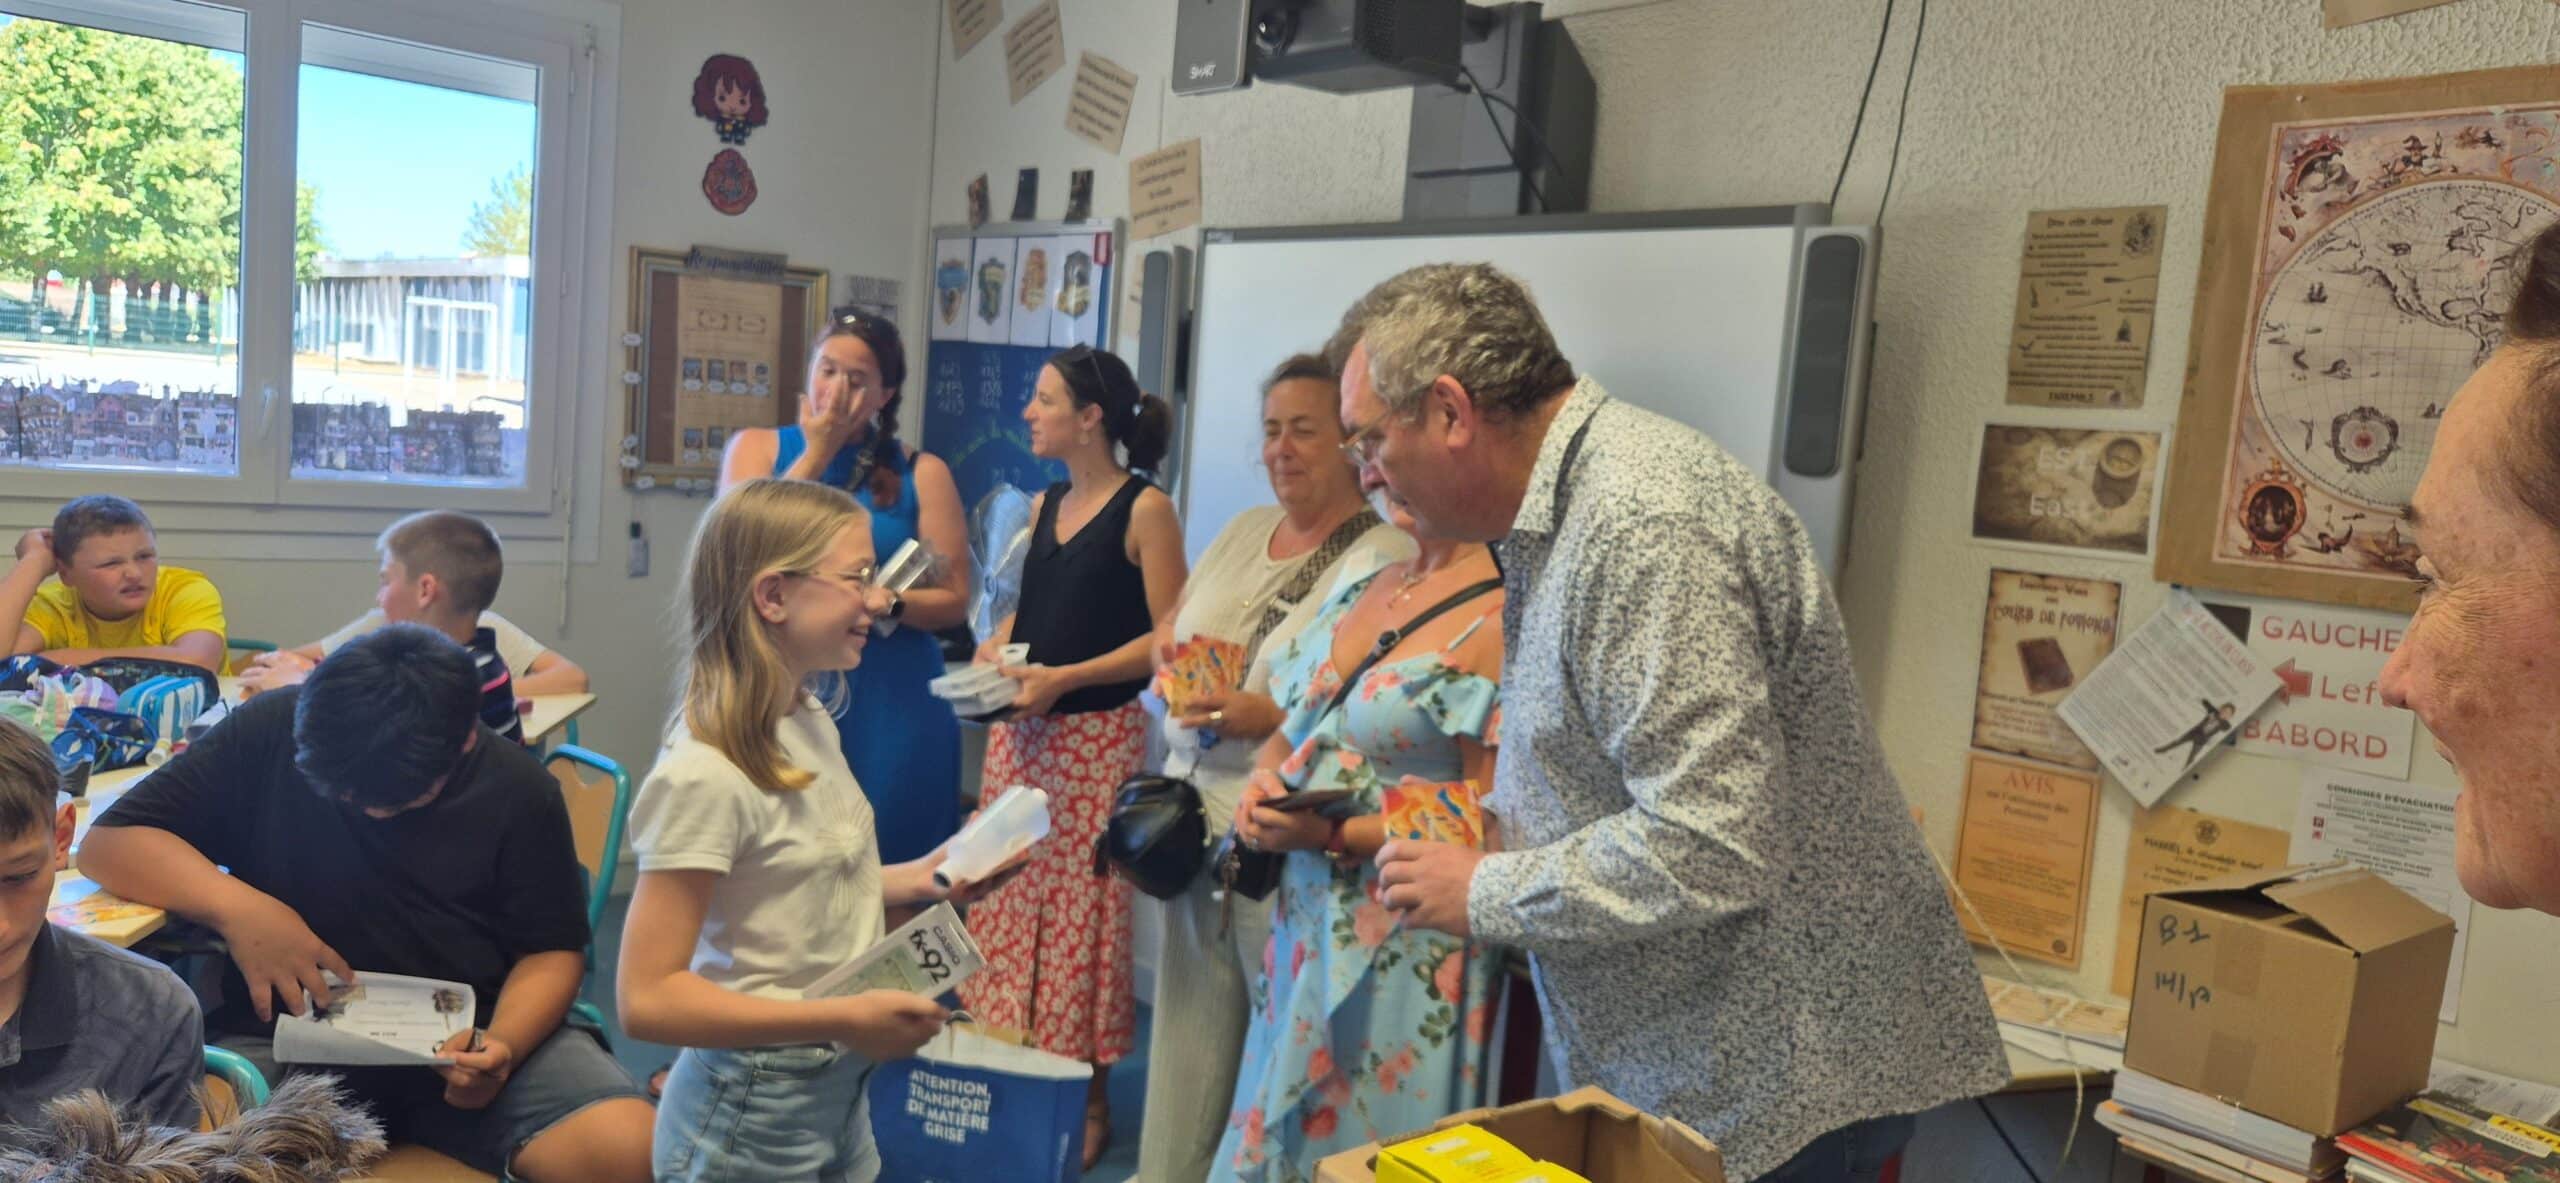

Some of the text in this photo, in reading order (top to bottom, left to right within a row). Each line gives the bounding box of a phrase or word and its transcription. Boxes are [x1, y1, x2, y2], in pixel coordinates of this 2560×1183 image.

[2262, 615, 2403, 653] GAUCHE
[2320, 675, 2380, 705] Lef
[2244, 718, 2388, 759] BABORD
[2003, 770, 2056, 796] AVIS
[932, 925, 961, 966] CASIO
[909, 1082, 991, 1114] TRANSPORT
[911, 1070, 992, 1099] ATTENTION,
[907, 1098, 925, 1116] DE
[925, 1121, 966, 1143] GRISE
